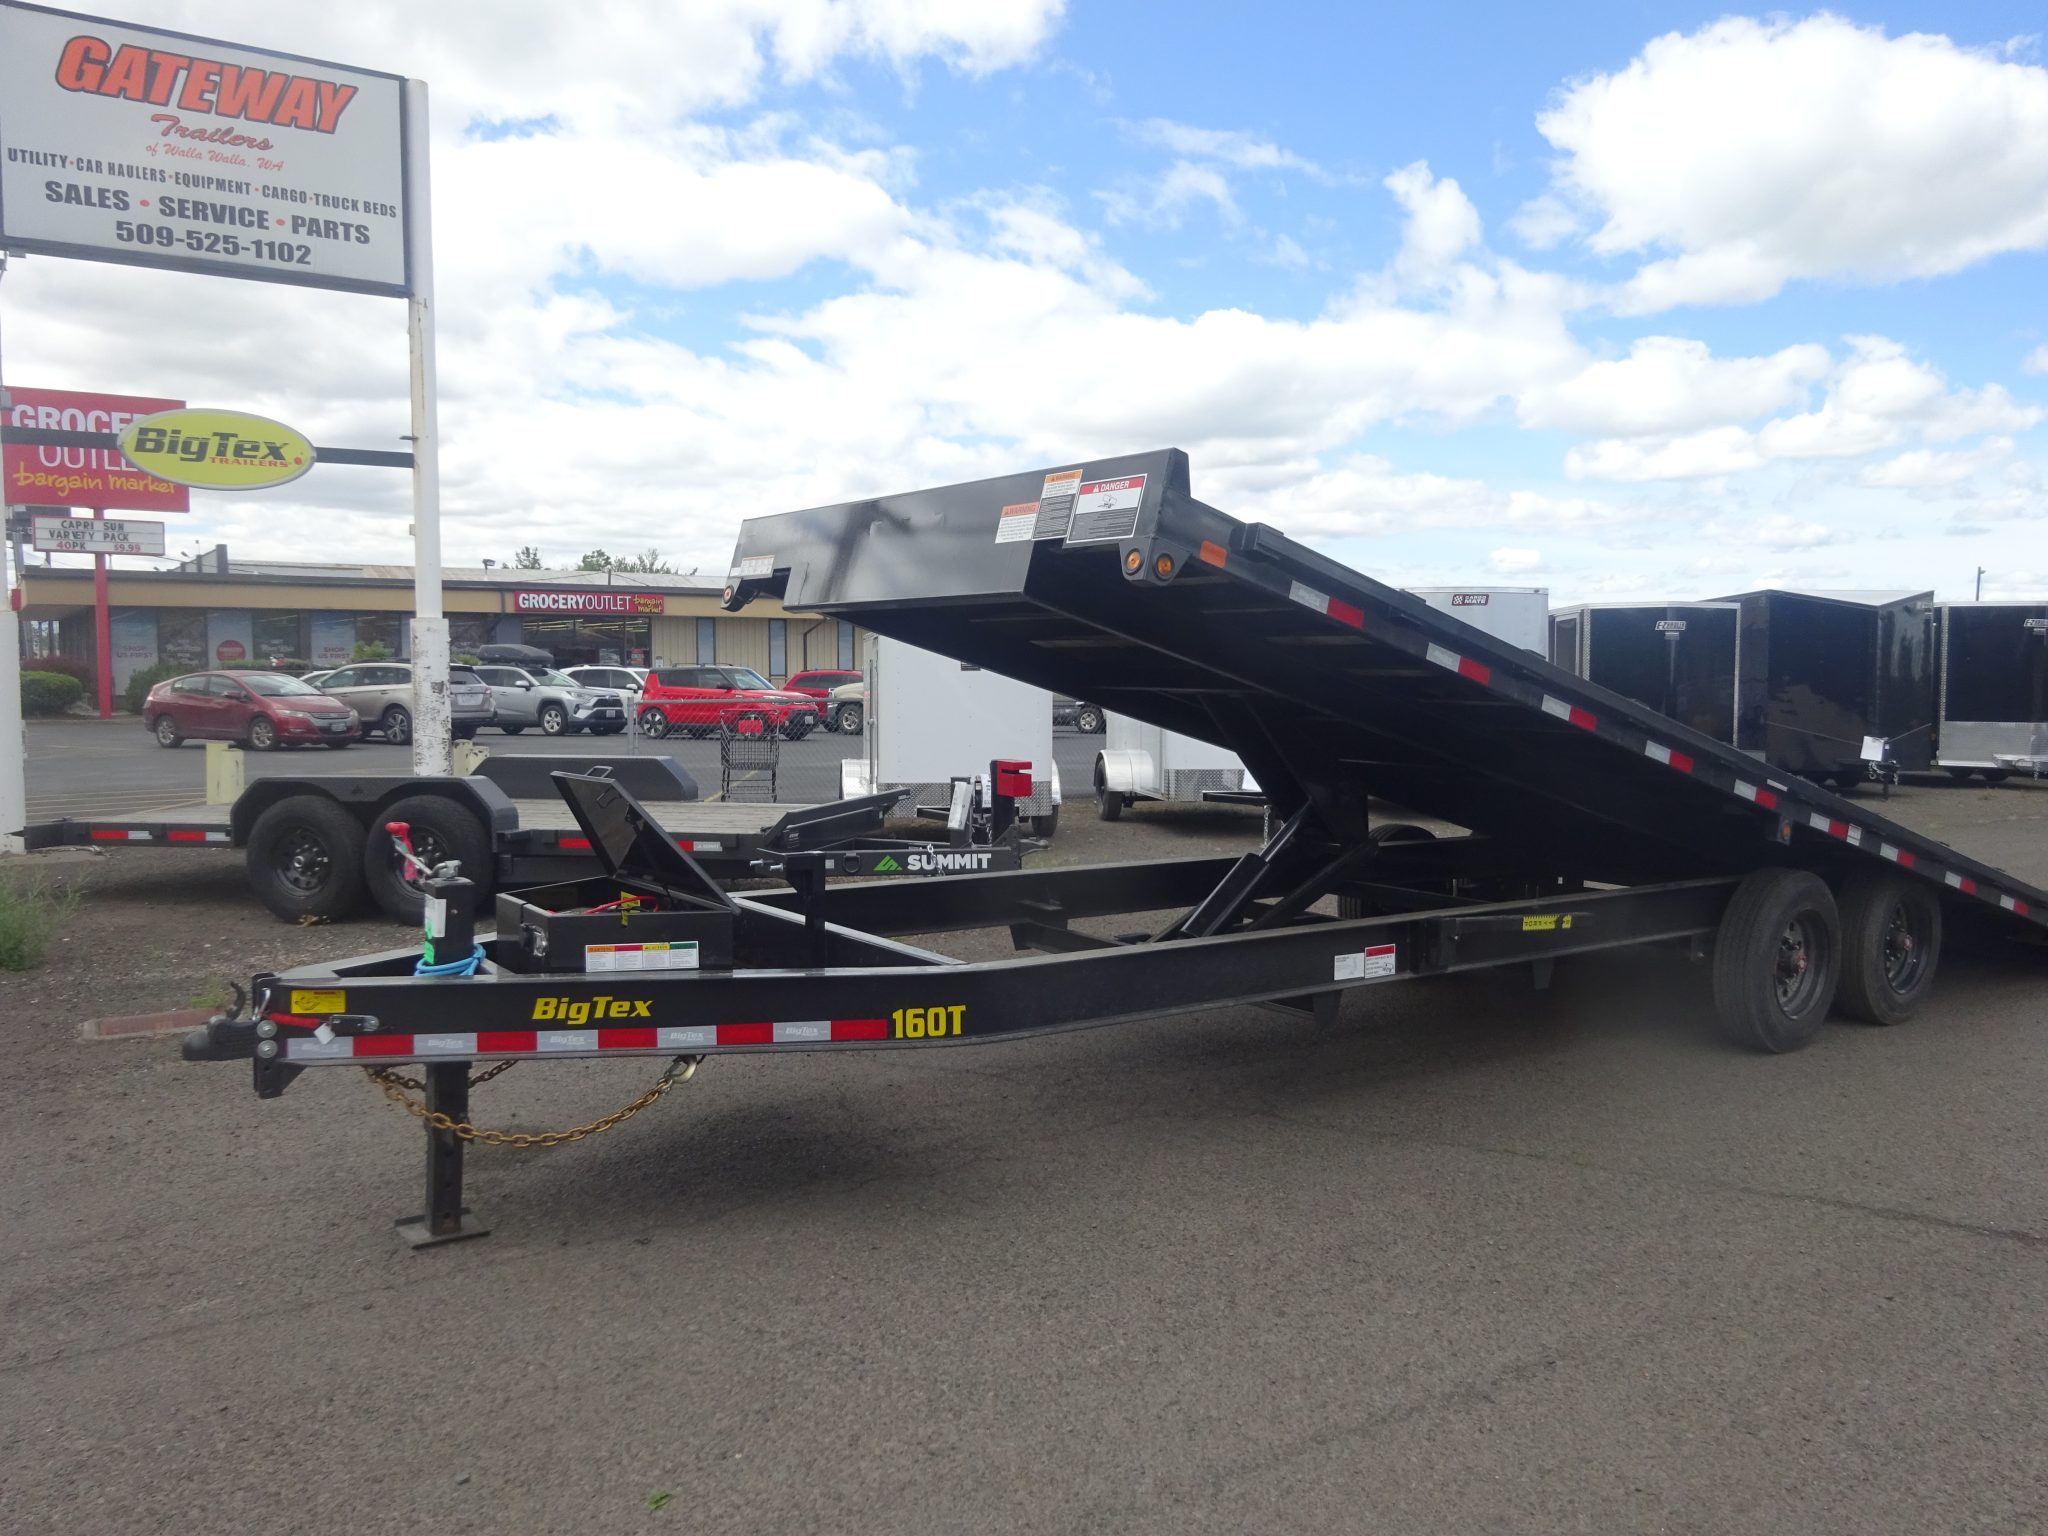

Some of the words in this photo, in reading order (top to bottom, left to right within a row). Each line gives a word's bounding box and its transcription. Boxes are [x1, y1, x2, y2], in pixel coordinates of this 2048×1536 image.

[55, 35, 358, 134] GATEWAY
[151, 114, 274, 150] Trailers
[146, 142, 159, 157] of
[163, 143, 203, 160] Walla
[257, 157, 285, 171] WA
[8, 147, 68, 168] UTILITY
[76, 157, 103, 174] CAR
[108, 162, 166, 183] HAULERS
[175, 171, 251, 196] EQUIPMENT
[262, 184, 307, 204] CARGO
[314, 192, 359, 212] TRUCK
[364, 201, 397, 218] BEDS
[45, 180, 130, 211] SALES
[158, 196, 270, 230] SERVICE
[291, 215, 370, 244] PARTS
[116, 220, 312, 265] 509-525-1102
[134, 427, 289, 462] BigTex
[209, 456, 289, 468] TRAILERS
[12, 460, 103, 497] bargain
[108, 474, 175, 495] market
[1100, 480, 1130, 493] DANGER
[49, 529, 94, 540] VARIETY
[103, 532, 129, 542] PACK
[61, 520, 94, 530] CAPRI
[103, 521, 124, 531] SUN
[633, 594, 663, 606] bargain
[907, 853, 992, 871] SUMMIT
[532, 996, 653, 1025] BigTex
[892, 1004, 967, 1039] 160T
[670, 1031, 704, 1041] BigTex
